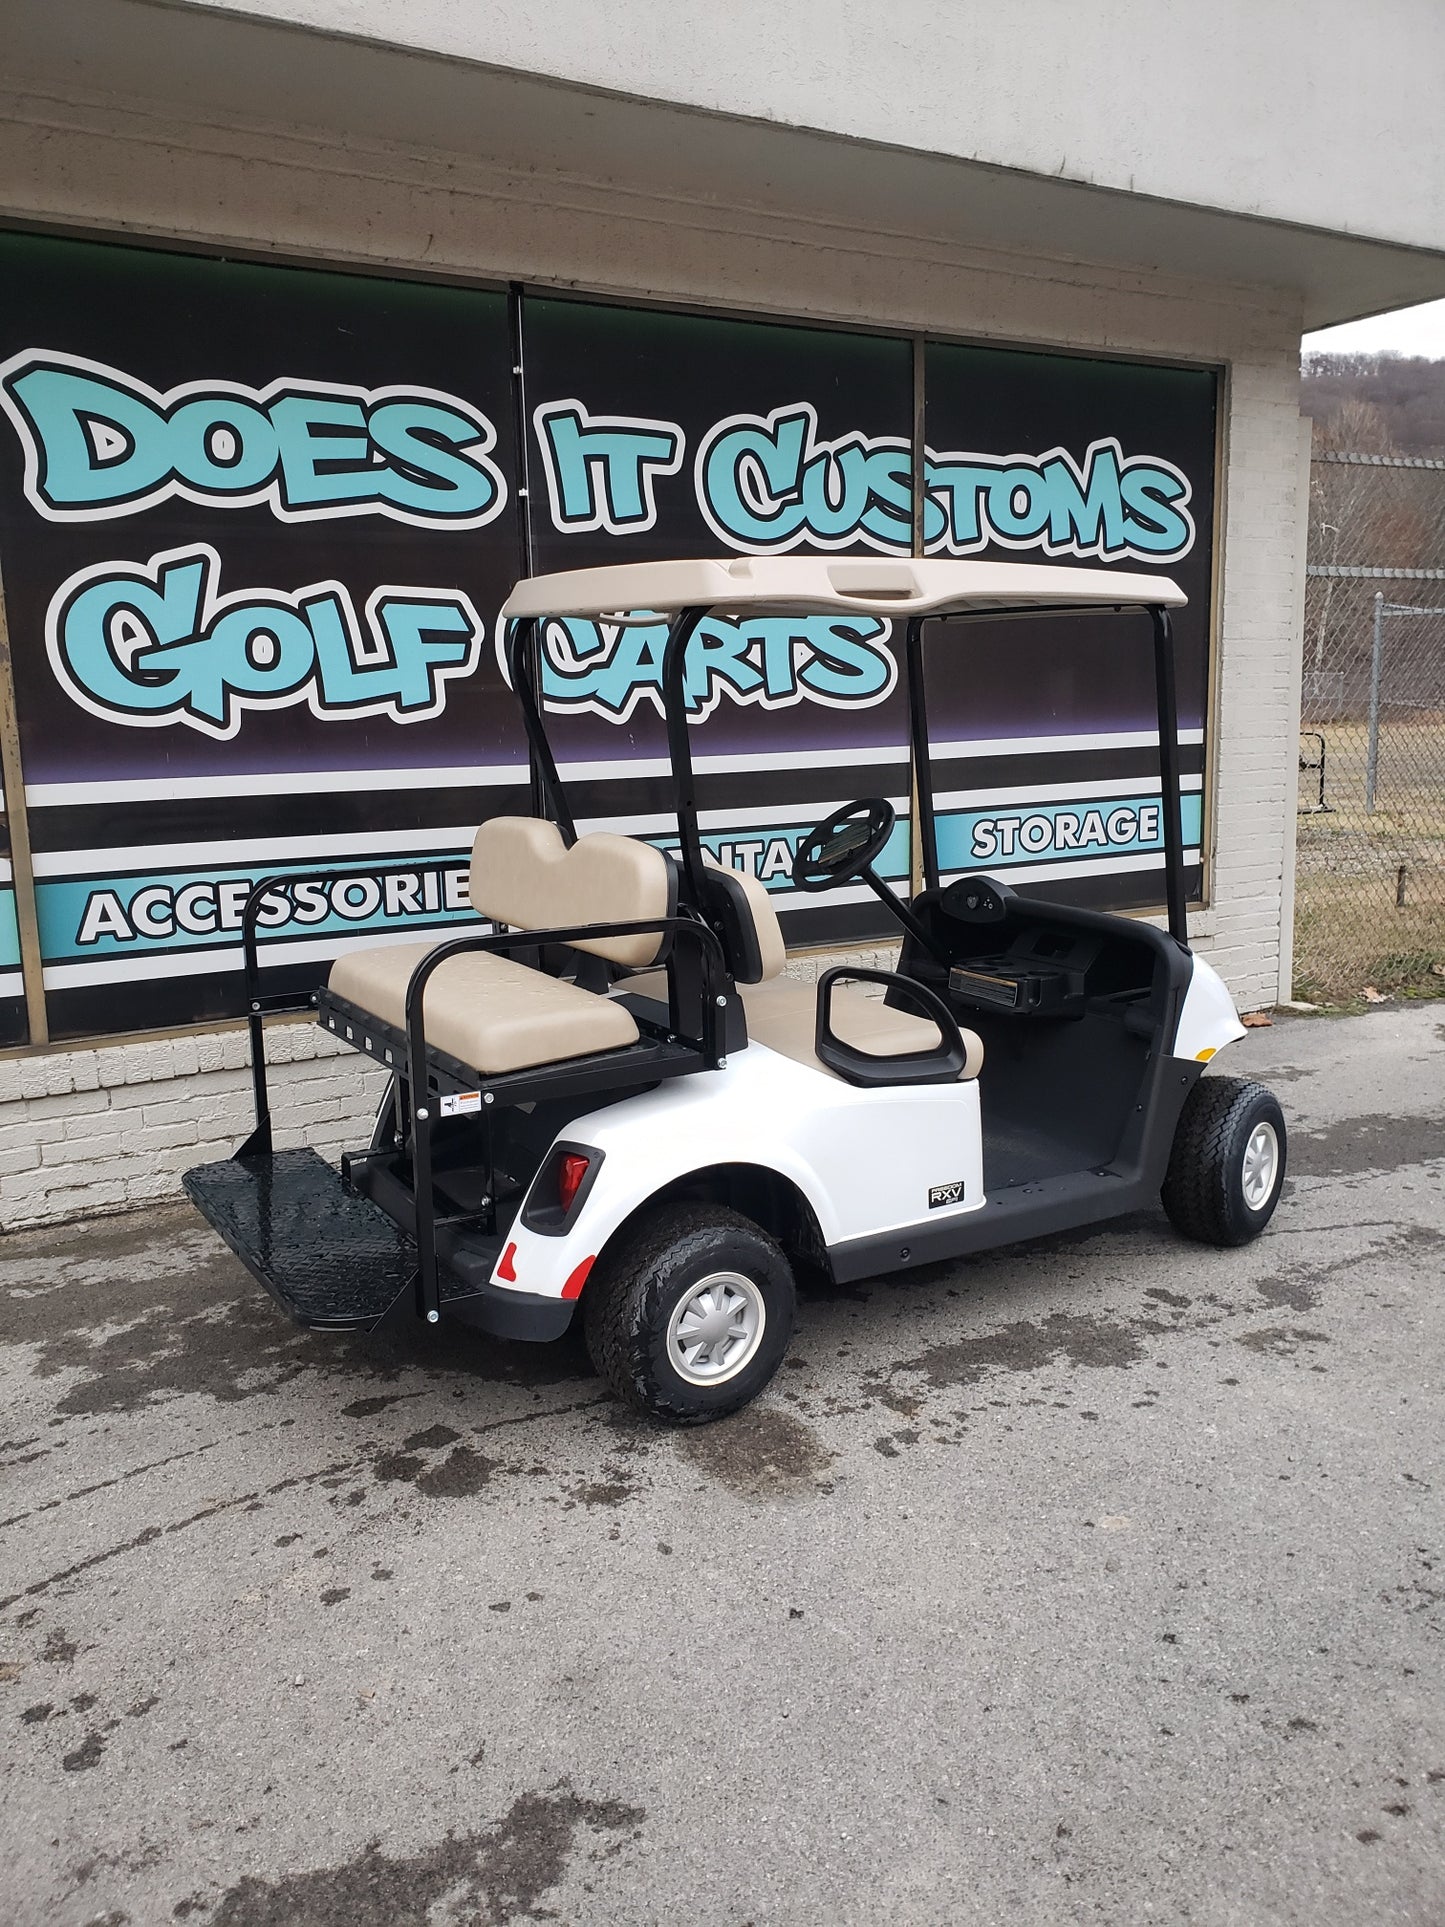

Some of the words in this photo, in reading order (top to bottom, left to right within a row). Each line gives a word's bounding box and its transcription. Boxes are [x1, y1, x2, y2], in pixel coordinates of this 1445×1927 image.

[3, 358, 502, 519] DOES
[540, 409, 679, 523] IT
[702, 411, 1192, 555] CUSTOMS
[58, 555, 477, 727] GOLF
[505, 608, 892, 712] CARTS
[970, 804, 1161, 859] STORAGE
[75, 867, 472, 945] ACCESSORIE
[931, 1187, 962, 1203] RXV
